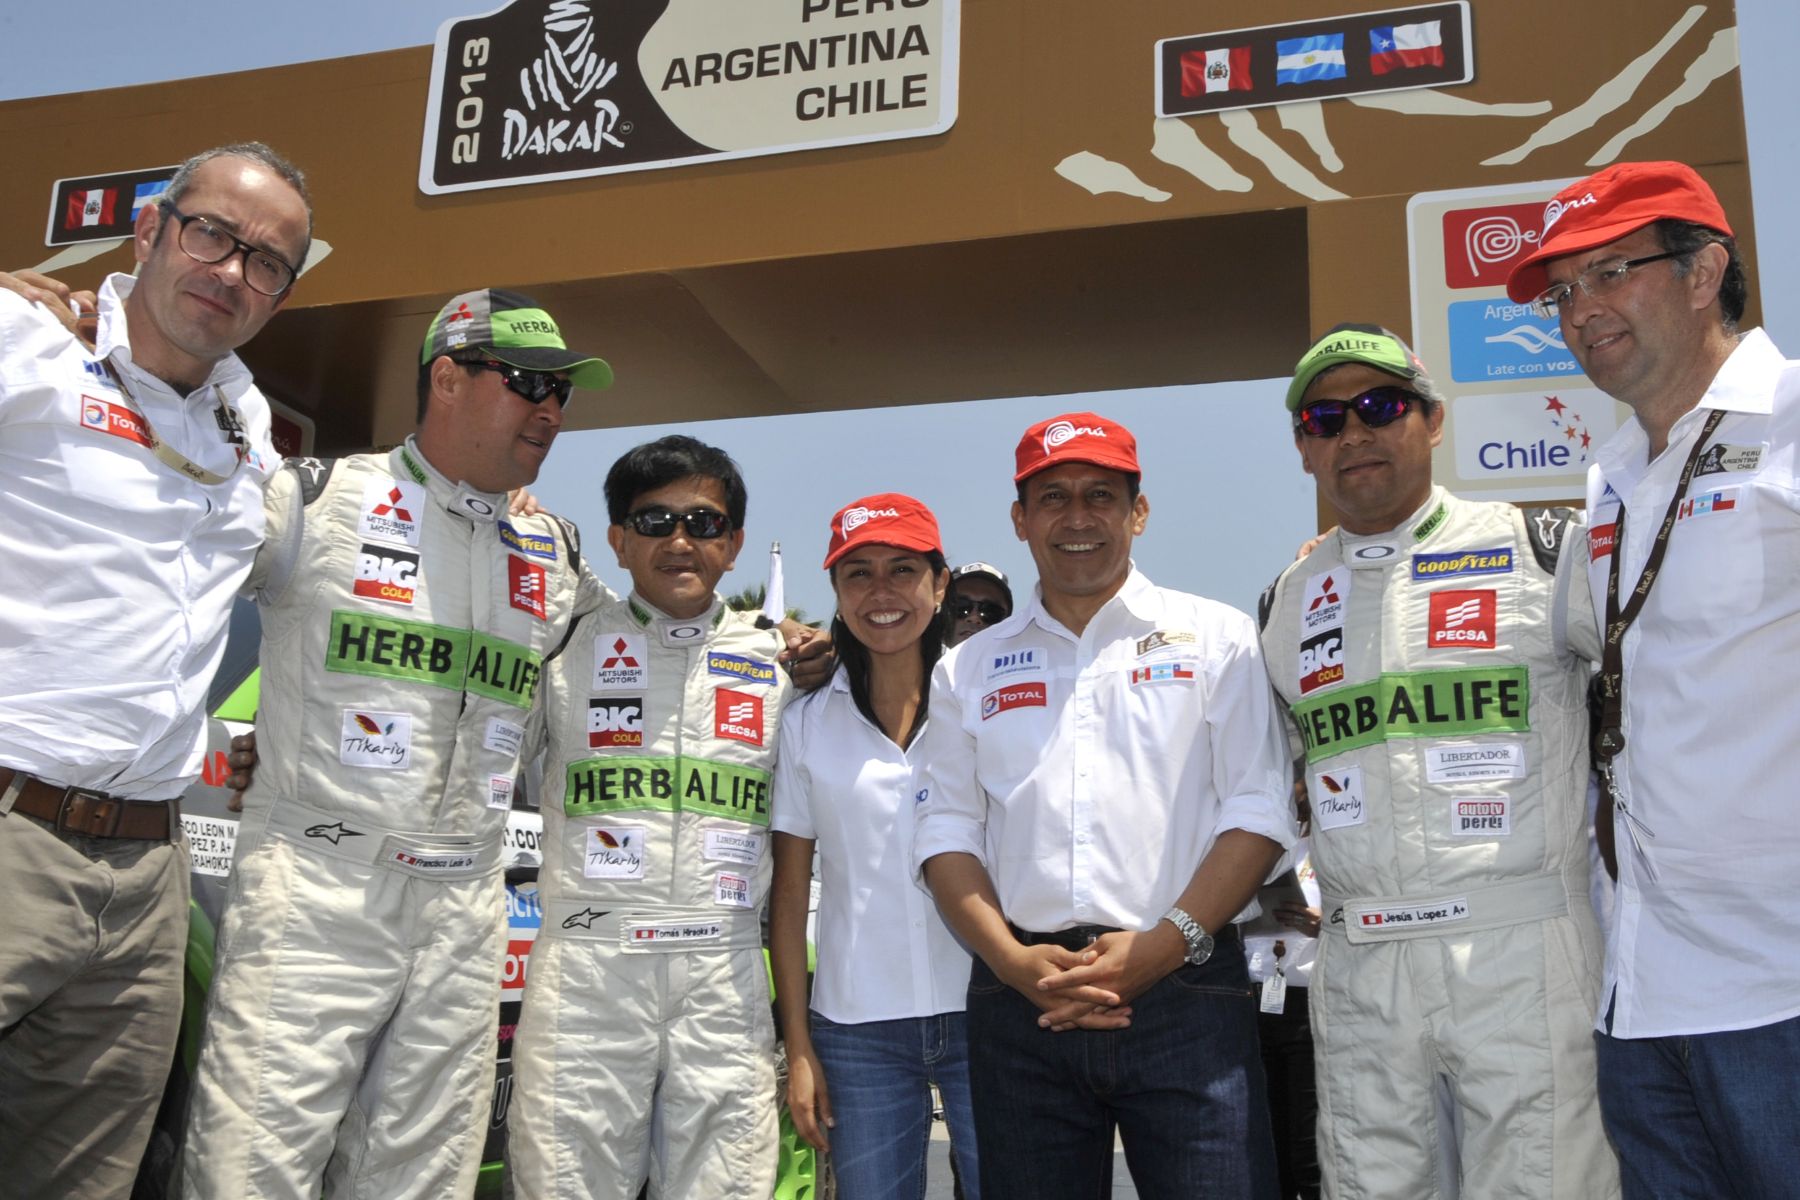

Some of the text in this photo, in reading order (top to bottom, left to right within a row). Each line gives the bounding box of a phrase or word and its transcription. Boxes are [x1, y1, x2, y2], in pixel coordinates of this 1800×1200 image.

[661, 25, 930, 91] ARGENTINA
[452, 36, 490, 164] 2013
[796, 73, 928, 122] CHILE
[502, 99, 624, 160] DAKAR
[1487, 360, 1576, 376] Late con vos
[1044, 420, 1106, 457] Perú
[1478, 439, 1570, 471] Chile
[366, 515, 415, 533] MITSUBISHI
[370, 524, 409, 538] MOTORS
[841, 506, 899, 541] Perú
[1592, 535, 1613, 549] TOTAL
[357, 553, 417, 590] BIG
[1416, 554, 1509, 574] GOODYEAR
[380, 586, 413, 601] COLA
[1435, 629, 1488, 642] PECSA
[1300, 637, 1343, 679] BIG
[598, 669, 642, 678] MITSUBISHI
[710, 657, 774, 680] GOODYEAR
[1317, 666, 1344, 682] COLA
[602, 676, 638, 684] MOTORS
[1000, 691, 1043, 703] TOTAL
[590, 706, 642, 733] BIG
[1299, 679, 1520, 751] HERBALIFE
[613, 733, 641, 744] COLA
[720, 722, 758, 739] PECSA
[1440, 750, 1511, 763] LIBERTADOR
[573, 767, 767, 814] HERBALIFE
[200, 824, 225, 838] LEON
[220, 841, 232, 855] A+
[1384, 904, 1466, 923] Jesús Lopez A+
[654, 927, 680, 938] Tomás
